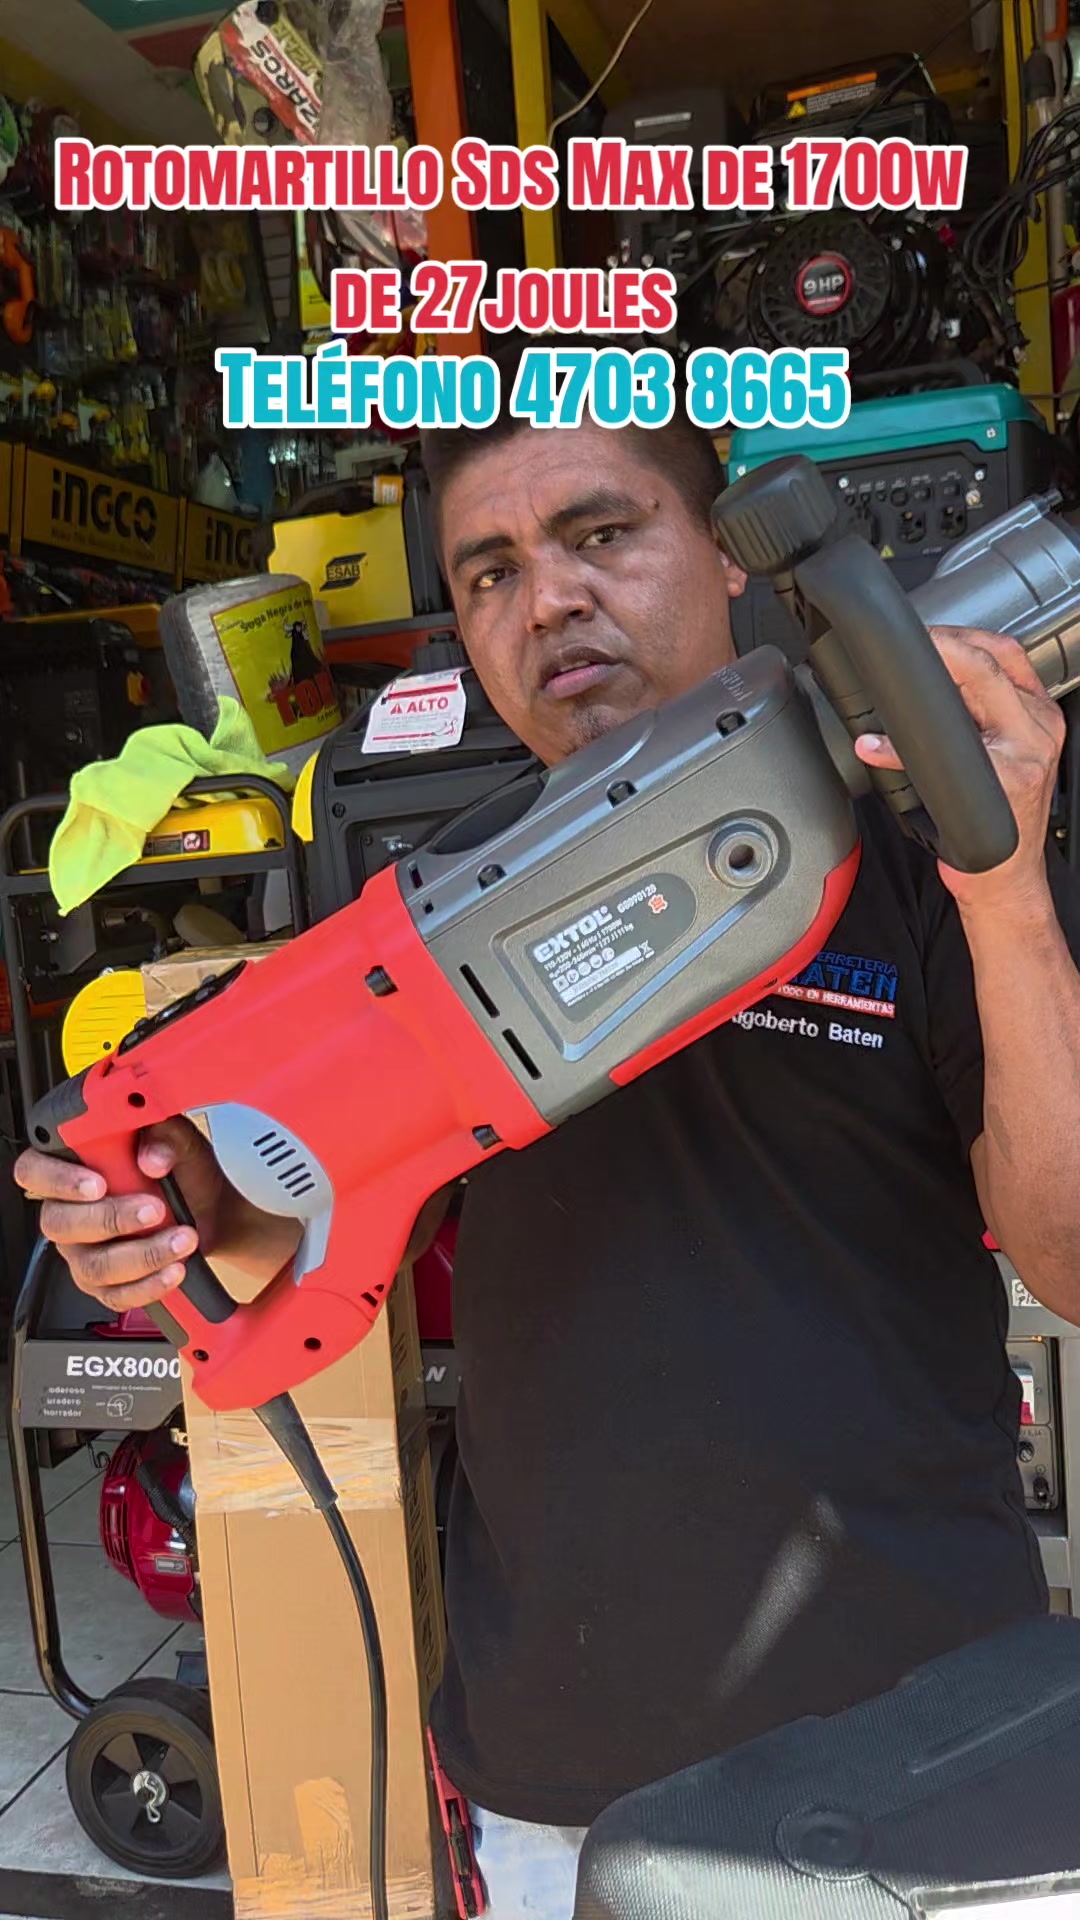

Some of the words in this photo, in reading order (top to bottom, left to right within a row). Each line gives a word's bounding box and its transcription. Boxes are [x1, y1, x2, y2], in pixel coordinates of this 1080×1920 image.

[249, 39, 322, 127] ZARCS
[327, 563, 360, 581] ESAB
[266, 603, 293, 621] Negra
[406, 696, 449, 713] ALTO
[816, 950, 900, 977] ERRETERIA
[792, 963, 897, 1001] ATEN
[806, 988, 820, 1000] EN
[822, 990, 896, 1014] HERRAMIENTAS
[828, 1022, 884, 1049] Baten
[66, 1355, 182, 1379] EGX8000
